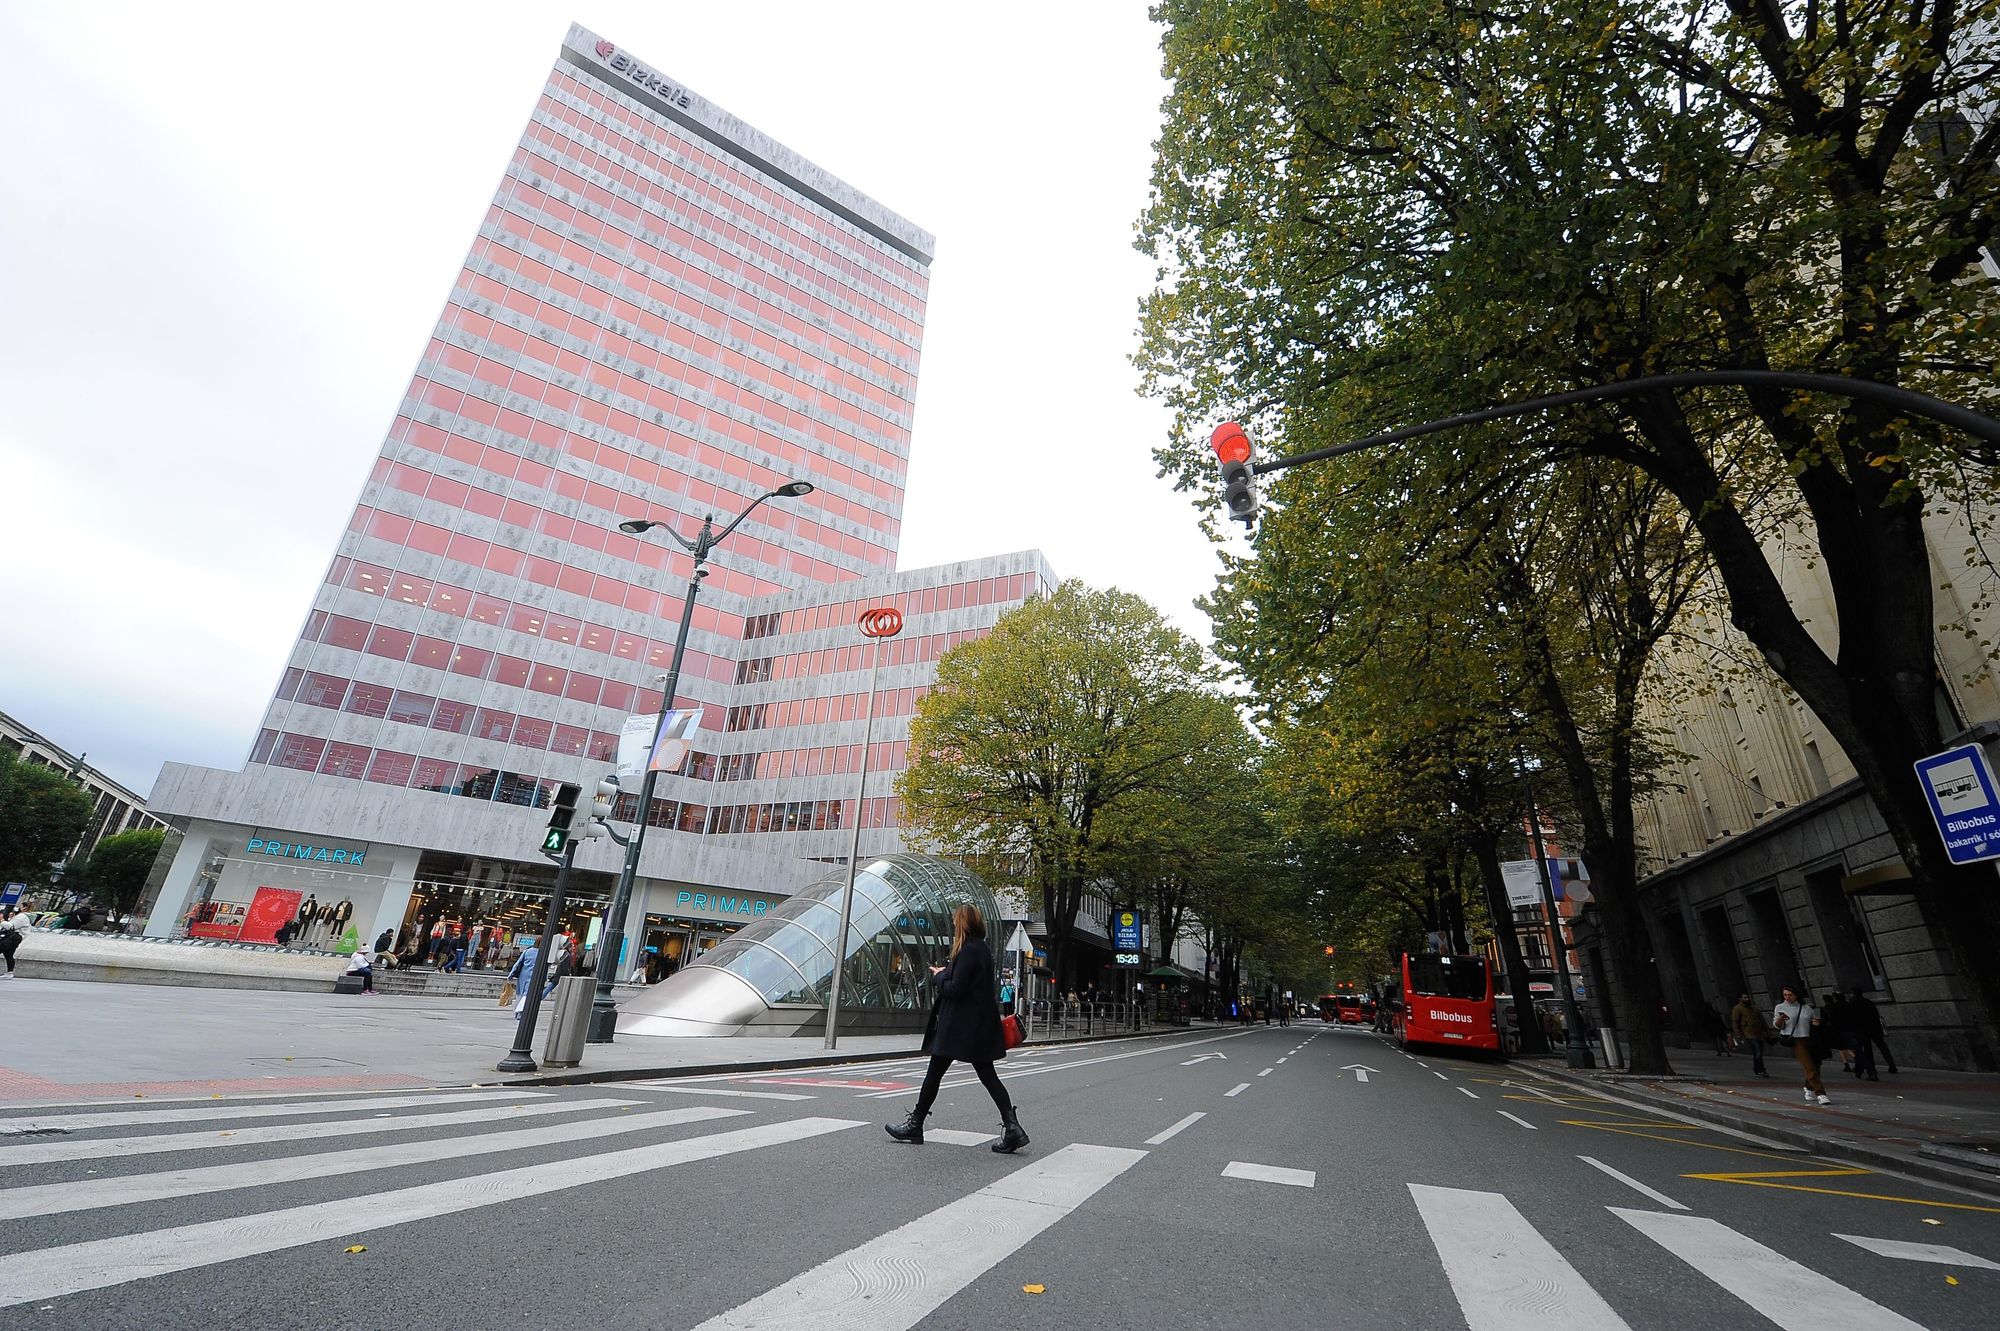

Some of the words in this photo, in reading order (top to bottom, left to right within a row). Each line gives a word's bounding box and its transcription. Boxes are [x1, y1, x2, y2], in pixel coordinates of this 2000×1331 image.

[610, 54, 691, 109] Bizkaia
[1946, 814, 1997, 833] Bilbobus
[1947, 834, 1983, 849] bakarrik
[1988, 829, 2000, 840] só
[246, 838, 367, 866] PRIMARK
[1115, 953, 1139, 964] 15:26
[1441, 957, 1451, 965] 01
[1430, 1009, 1473, 1024] Bilbobus
